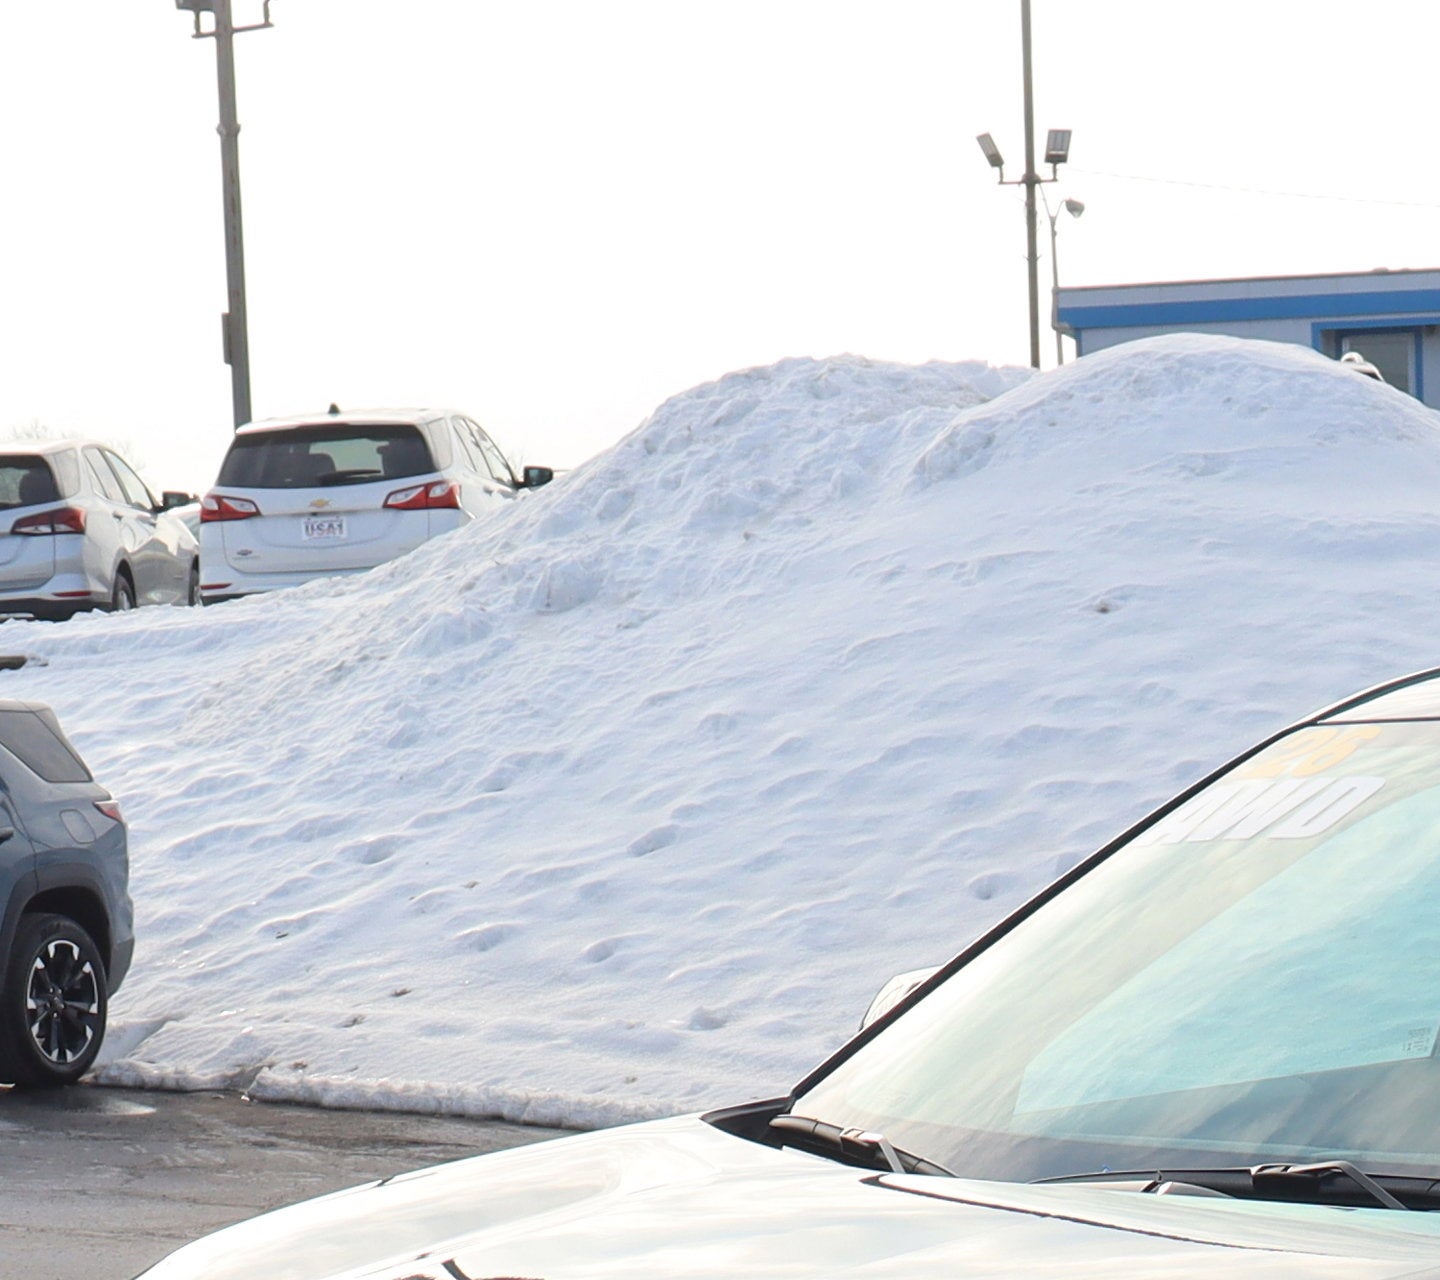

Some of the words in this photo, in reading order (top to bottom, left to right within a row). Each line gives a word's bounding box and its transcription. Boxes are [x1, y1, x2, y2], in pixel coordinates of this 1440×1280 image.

[305, 520, 344, 537] USA1
[1241, 726, 1382, 778] 26
[1134, 776, 1386, 845] AWD
